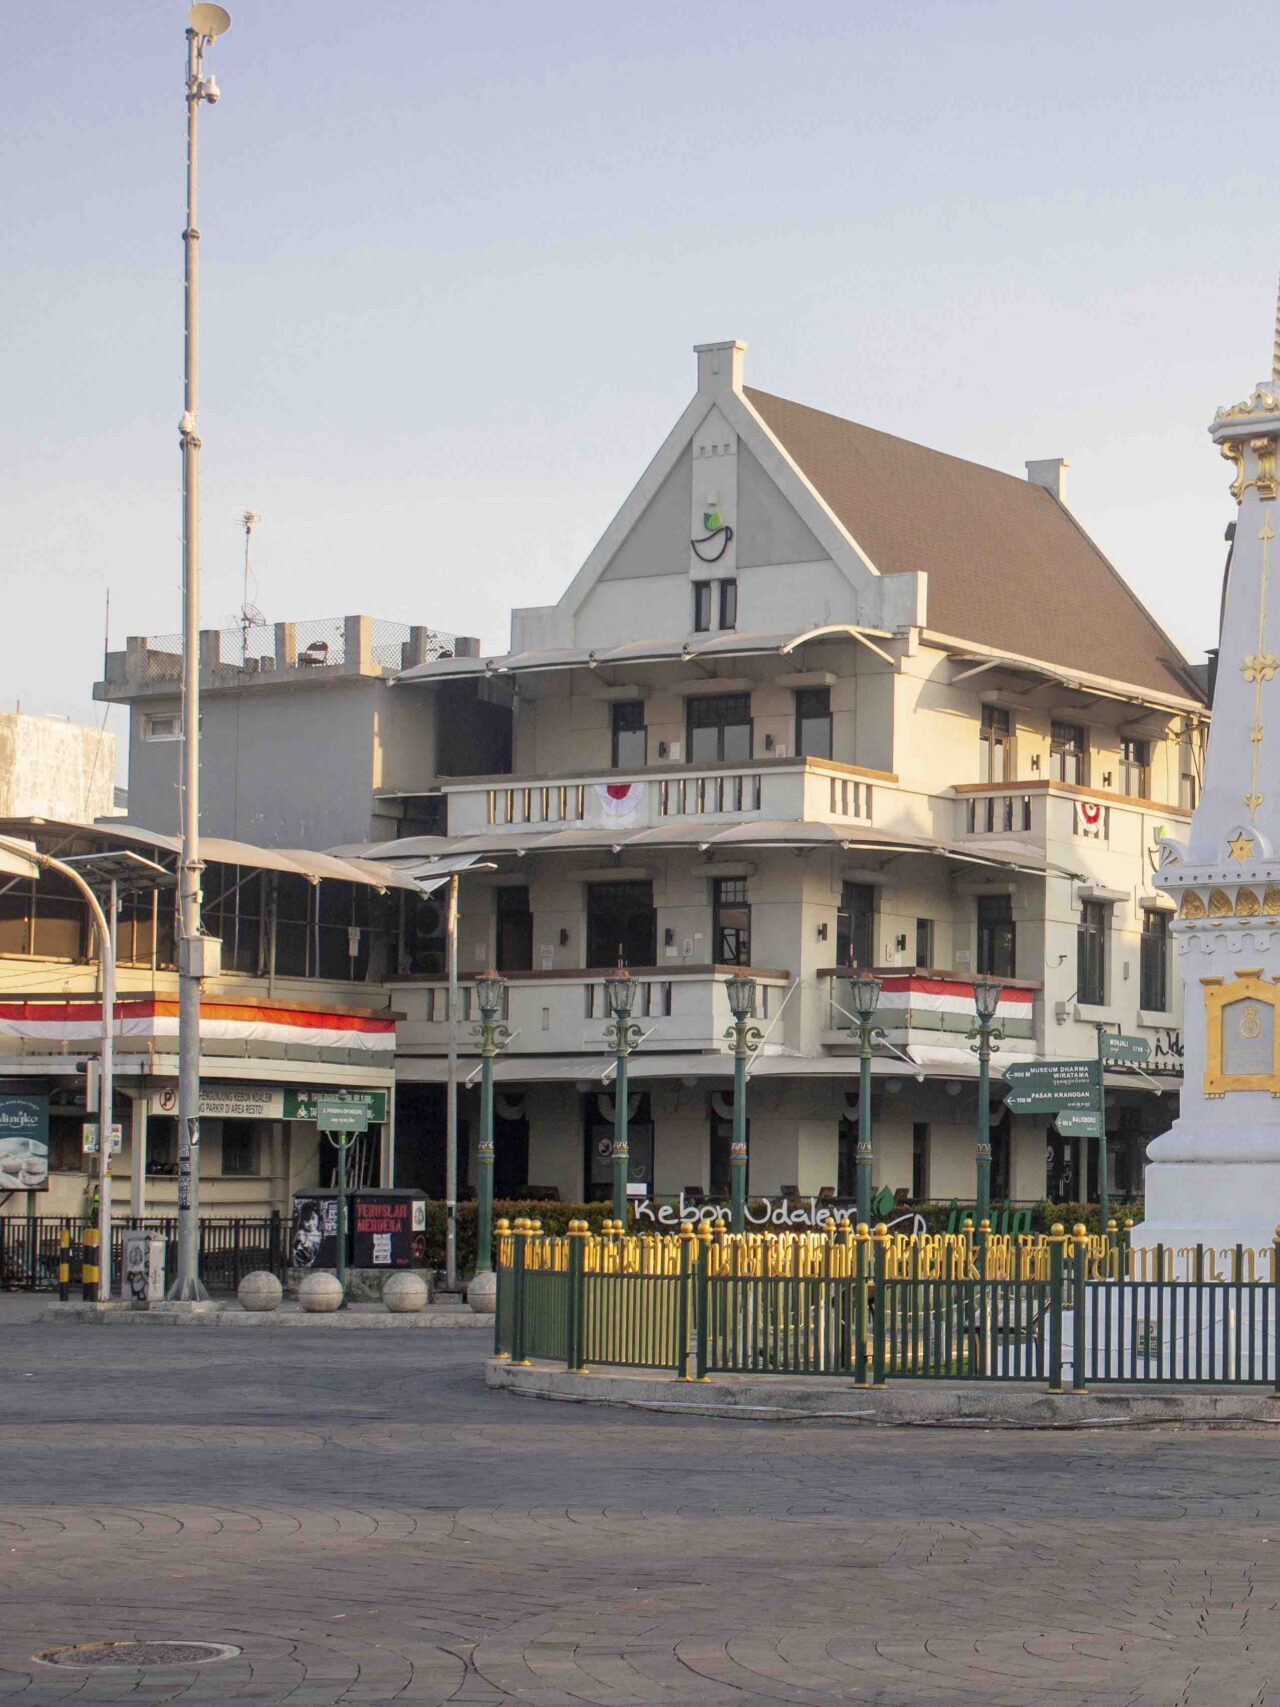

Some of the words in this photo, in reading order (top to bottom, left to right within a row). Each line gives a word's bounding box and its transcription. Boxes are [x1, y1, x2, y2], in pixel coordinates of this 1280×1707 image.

[206, 1103, 224, 1112] PARKIR
[231, 1104, 245, 1113] AREA
[634, 1192, 732, 1224] Kebon
